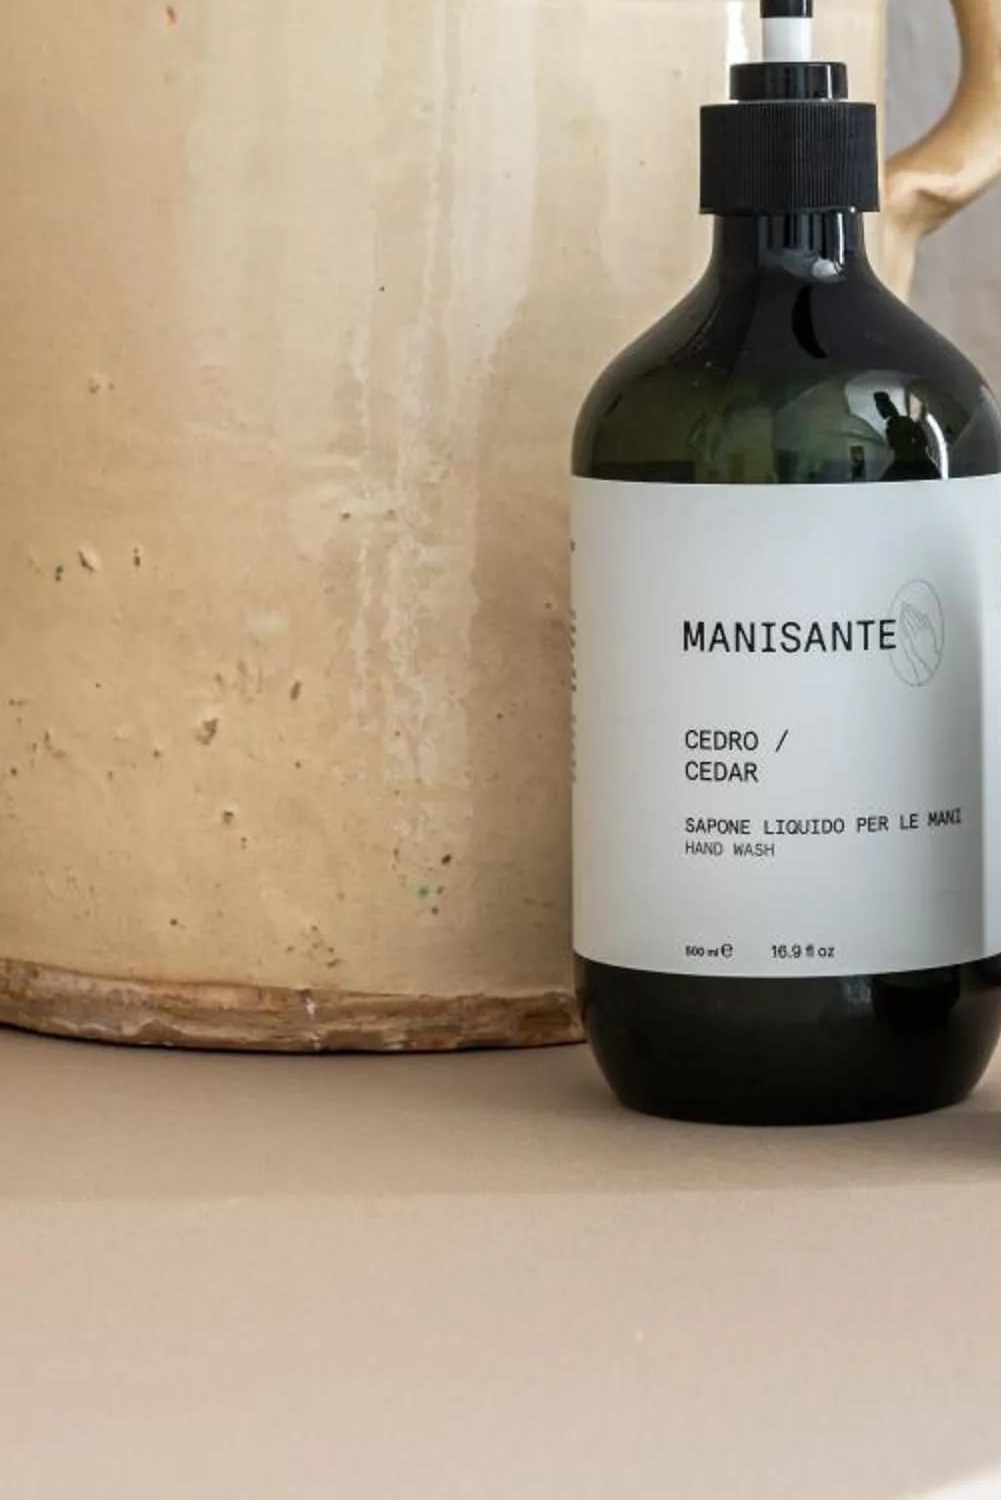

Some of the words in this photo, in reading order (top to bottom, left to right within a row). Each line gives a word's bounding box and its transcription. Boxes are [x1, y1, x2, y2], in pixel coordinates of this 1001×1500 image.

[683, 618, 897, 654] MANISANTE
[684, 729, 759, 752] CEDRO
[774, 728, 789, 753] /
[684, 759, 759, 783] CEDAR
[684, 816, 751, 836] SAPONE
[763, 817, 846, 836] LIQUIDO
[855, 815, 889, 833] PER
[899, 812, 920, 831] LE
[926, 807, 962, 827] MANI
[684, 840, 724, 857] HAND
[732, 842, 775, 858] WASH
[770, 943, 803, 960] 16.9
[817, 946, 835, 959] oz
